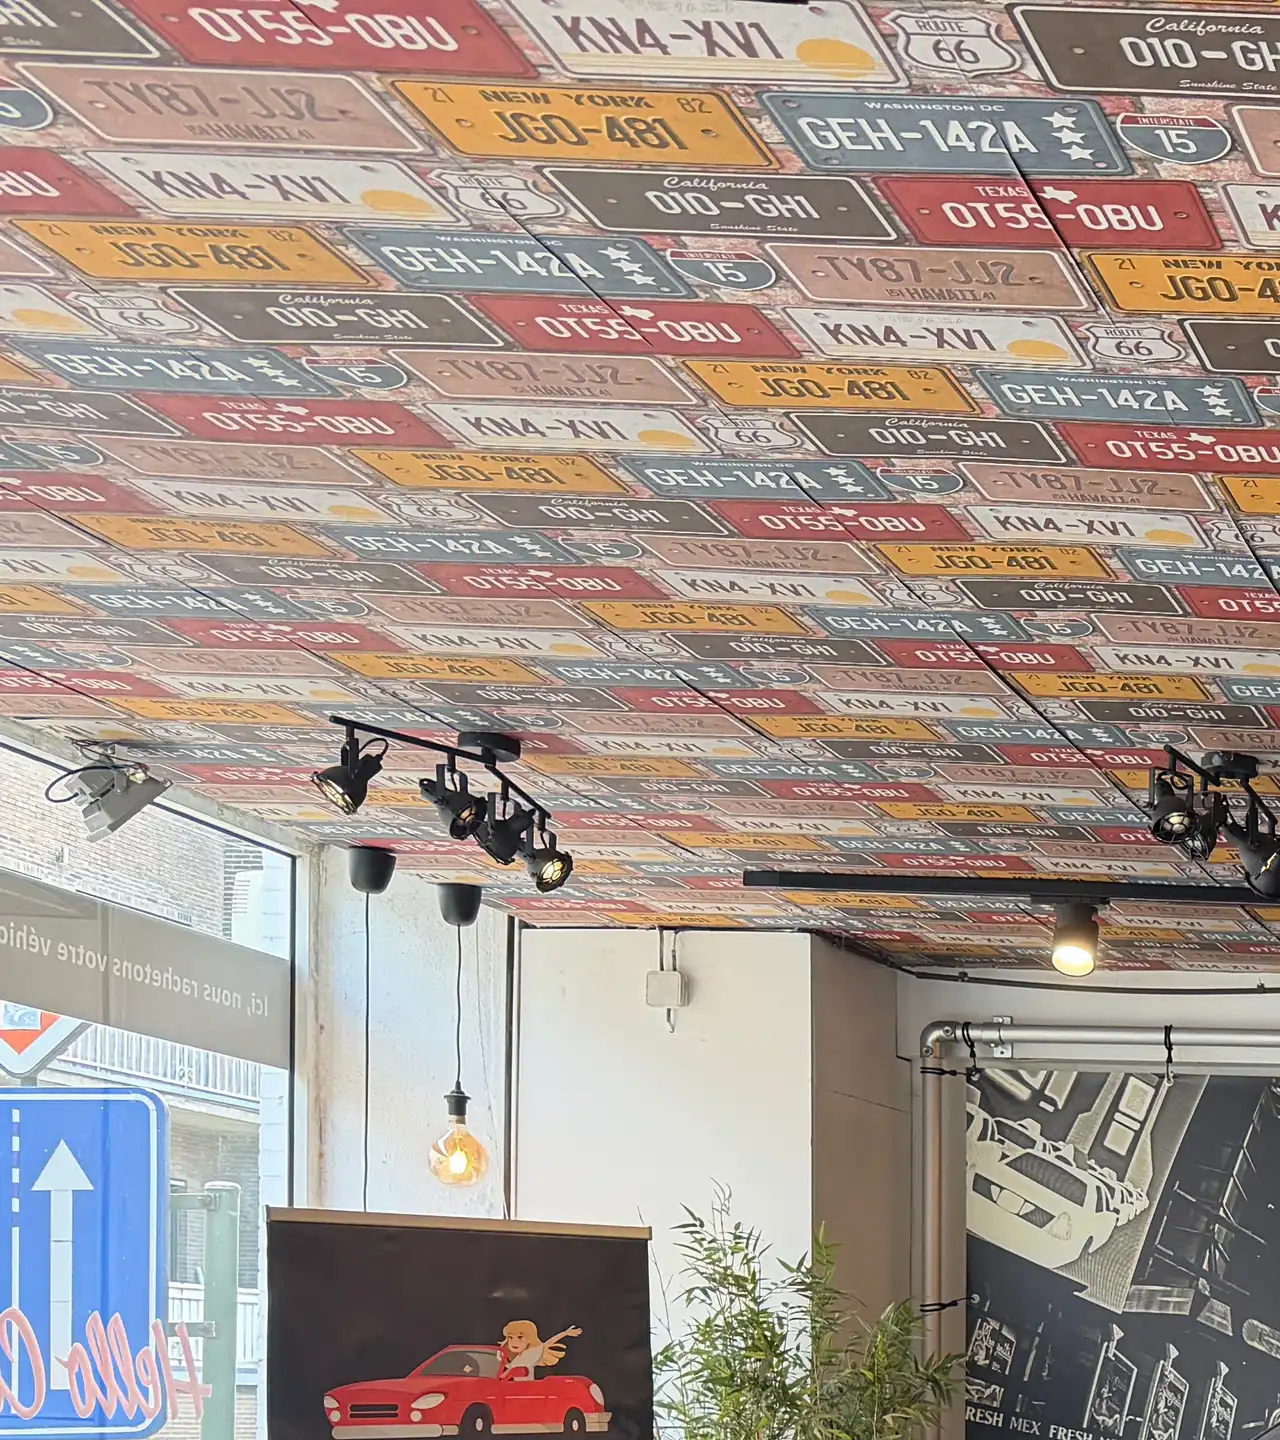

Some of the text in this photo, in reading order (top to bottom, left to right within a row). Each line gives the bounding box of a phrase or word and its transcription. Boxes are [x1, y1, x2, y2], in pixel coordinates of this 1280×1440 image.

[547, 12, 790, 65] KN4-XV1
[911, 18, 970, 35] ROUTE
[1140, 15, 1267, 39] California
[923, 37, 984, 65] 66
[420, 86, 715, 115] 21 NEW YORK 82
[791, 115, 1041, 154] GEH-142A
[1151, 128, 1201, 156] 15
[656, 175, 774, 193] California
[374, 244, 608, 280] GEH-142A
[965, 1405, 1004, 1428] RESH
[1009, 1417, 1042, 1436] MEX
